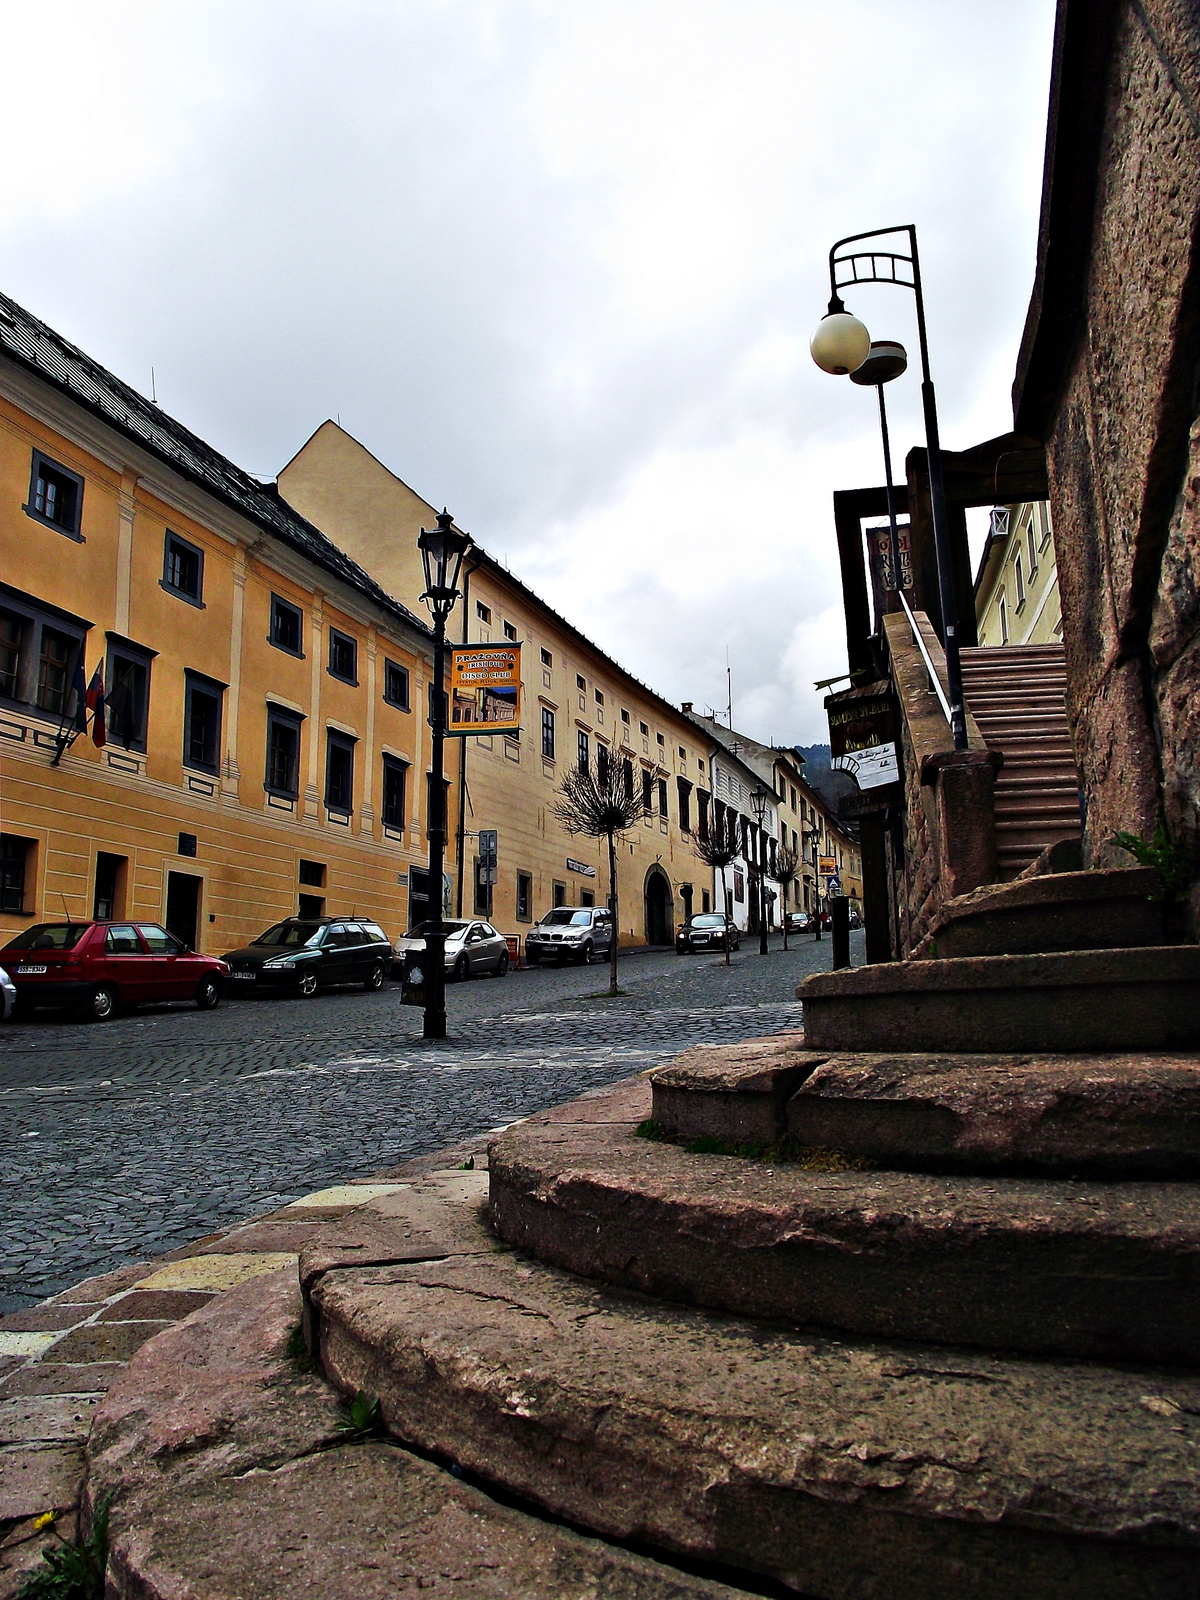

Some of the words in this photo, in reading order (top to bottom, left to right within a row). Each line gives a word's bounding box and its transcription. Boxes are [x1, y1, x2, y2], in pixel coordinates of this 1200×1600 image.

[456, 653, 516, 663] PRAŽOVŇA
[468, 661, 488, 669] IRISH
[461, 672, 488, 680] DISCO
[489, 671, 511, 679] CLUB
